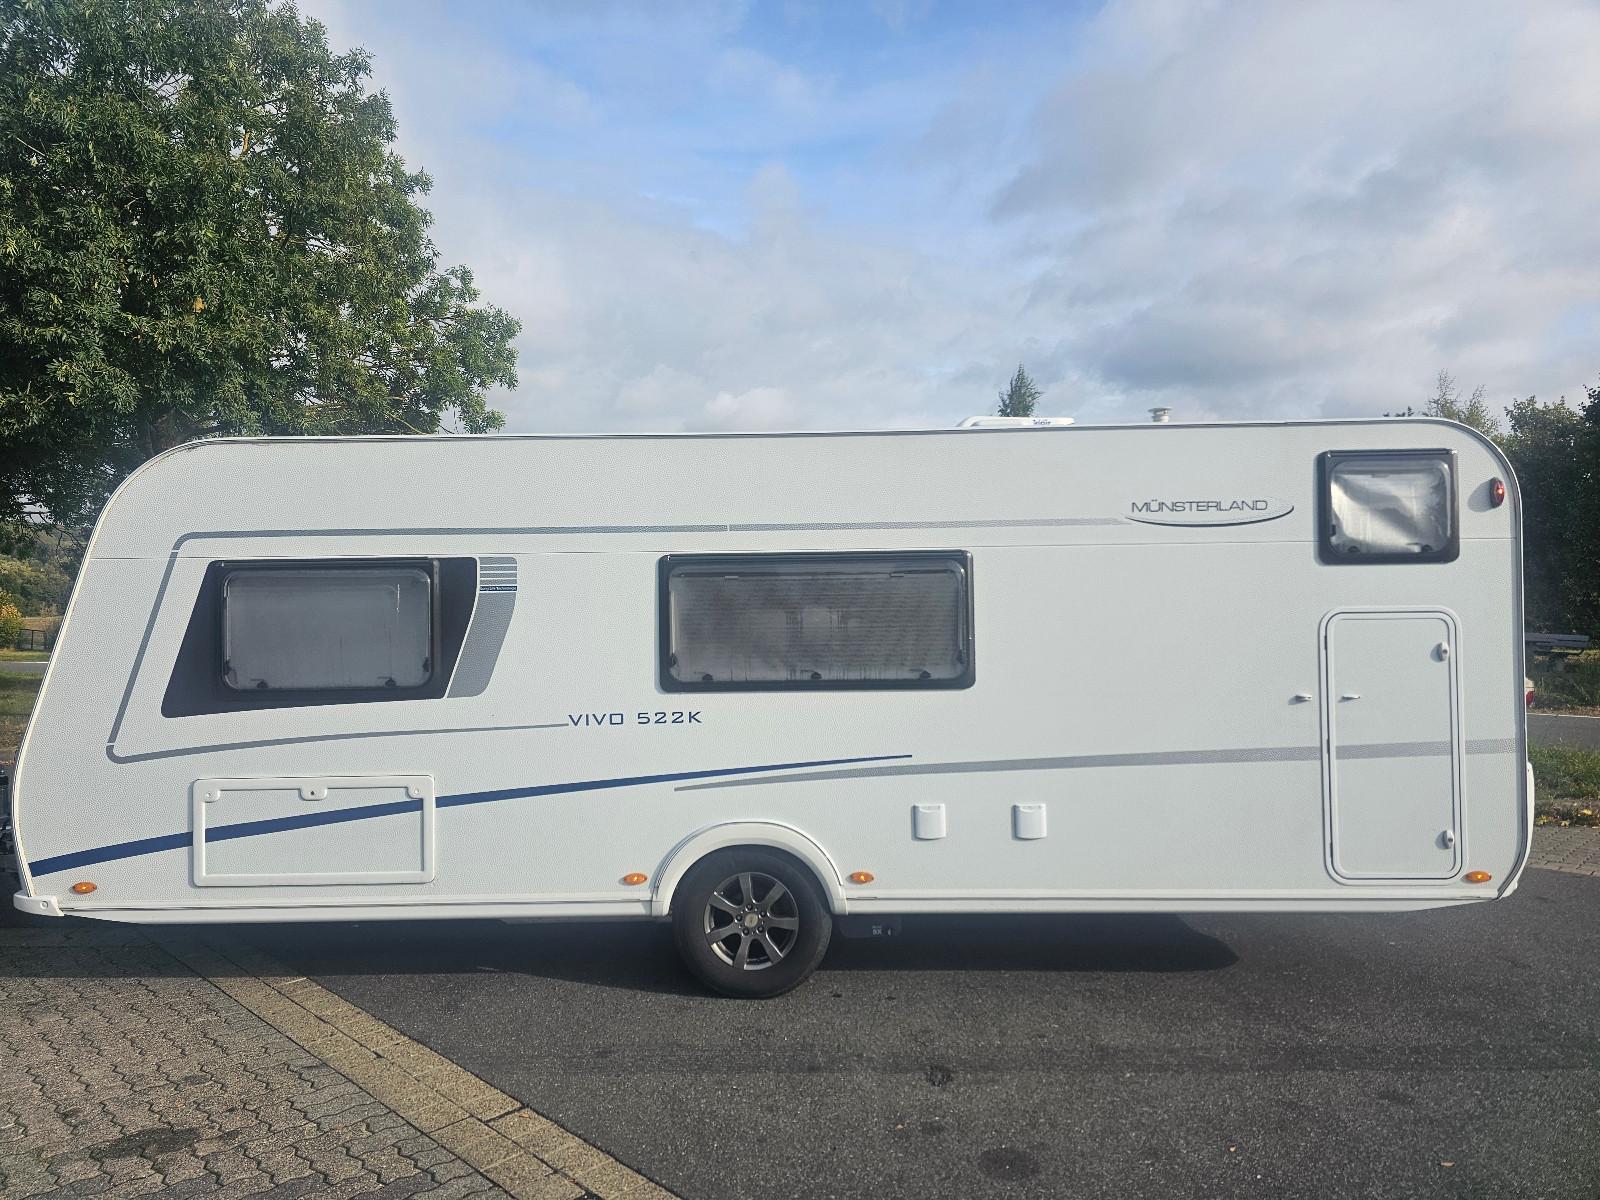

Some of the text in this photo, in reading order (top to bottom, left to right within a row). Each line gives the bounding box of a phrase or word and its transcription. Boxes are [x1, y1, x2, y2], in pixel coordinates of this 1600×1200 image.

[1131, 499, 1268, 513] MÜNSTERLAND
[568, 711, 702, 726] VIVO 522K
